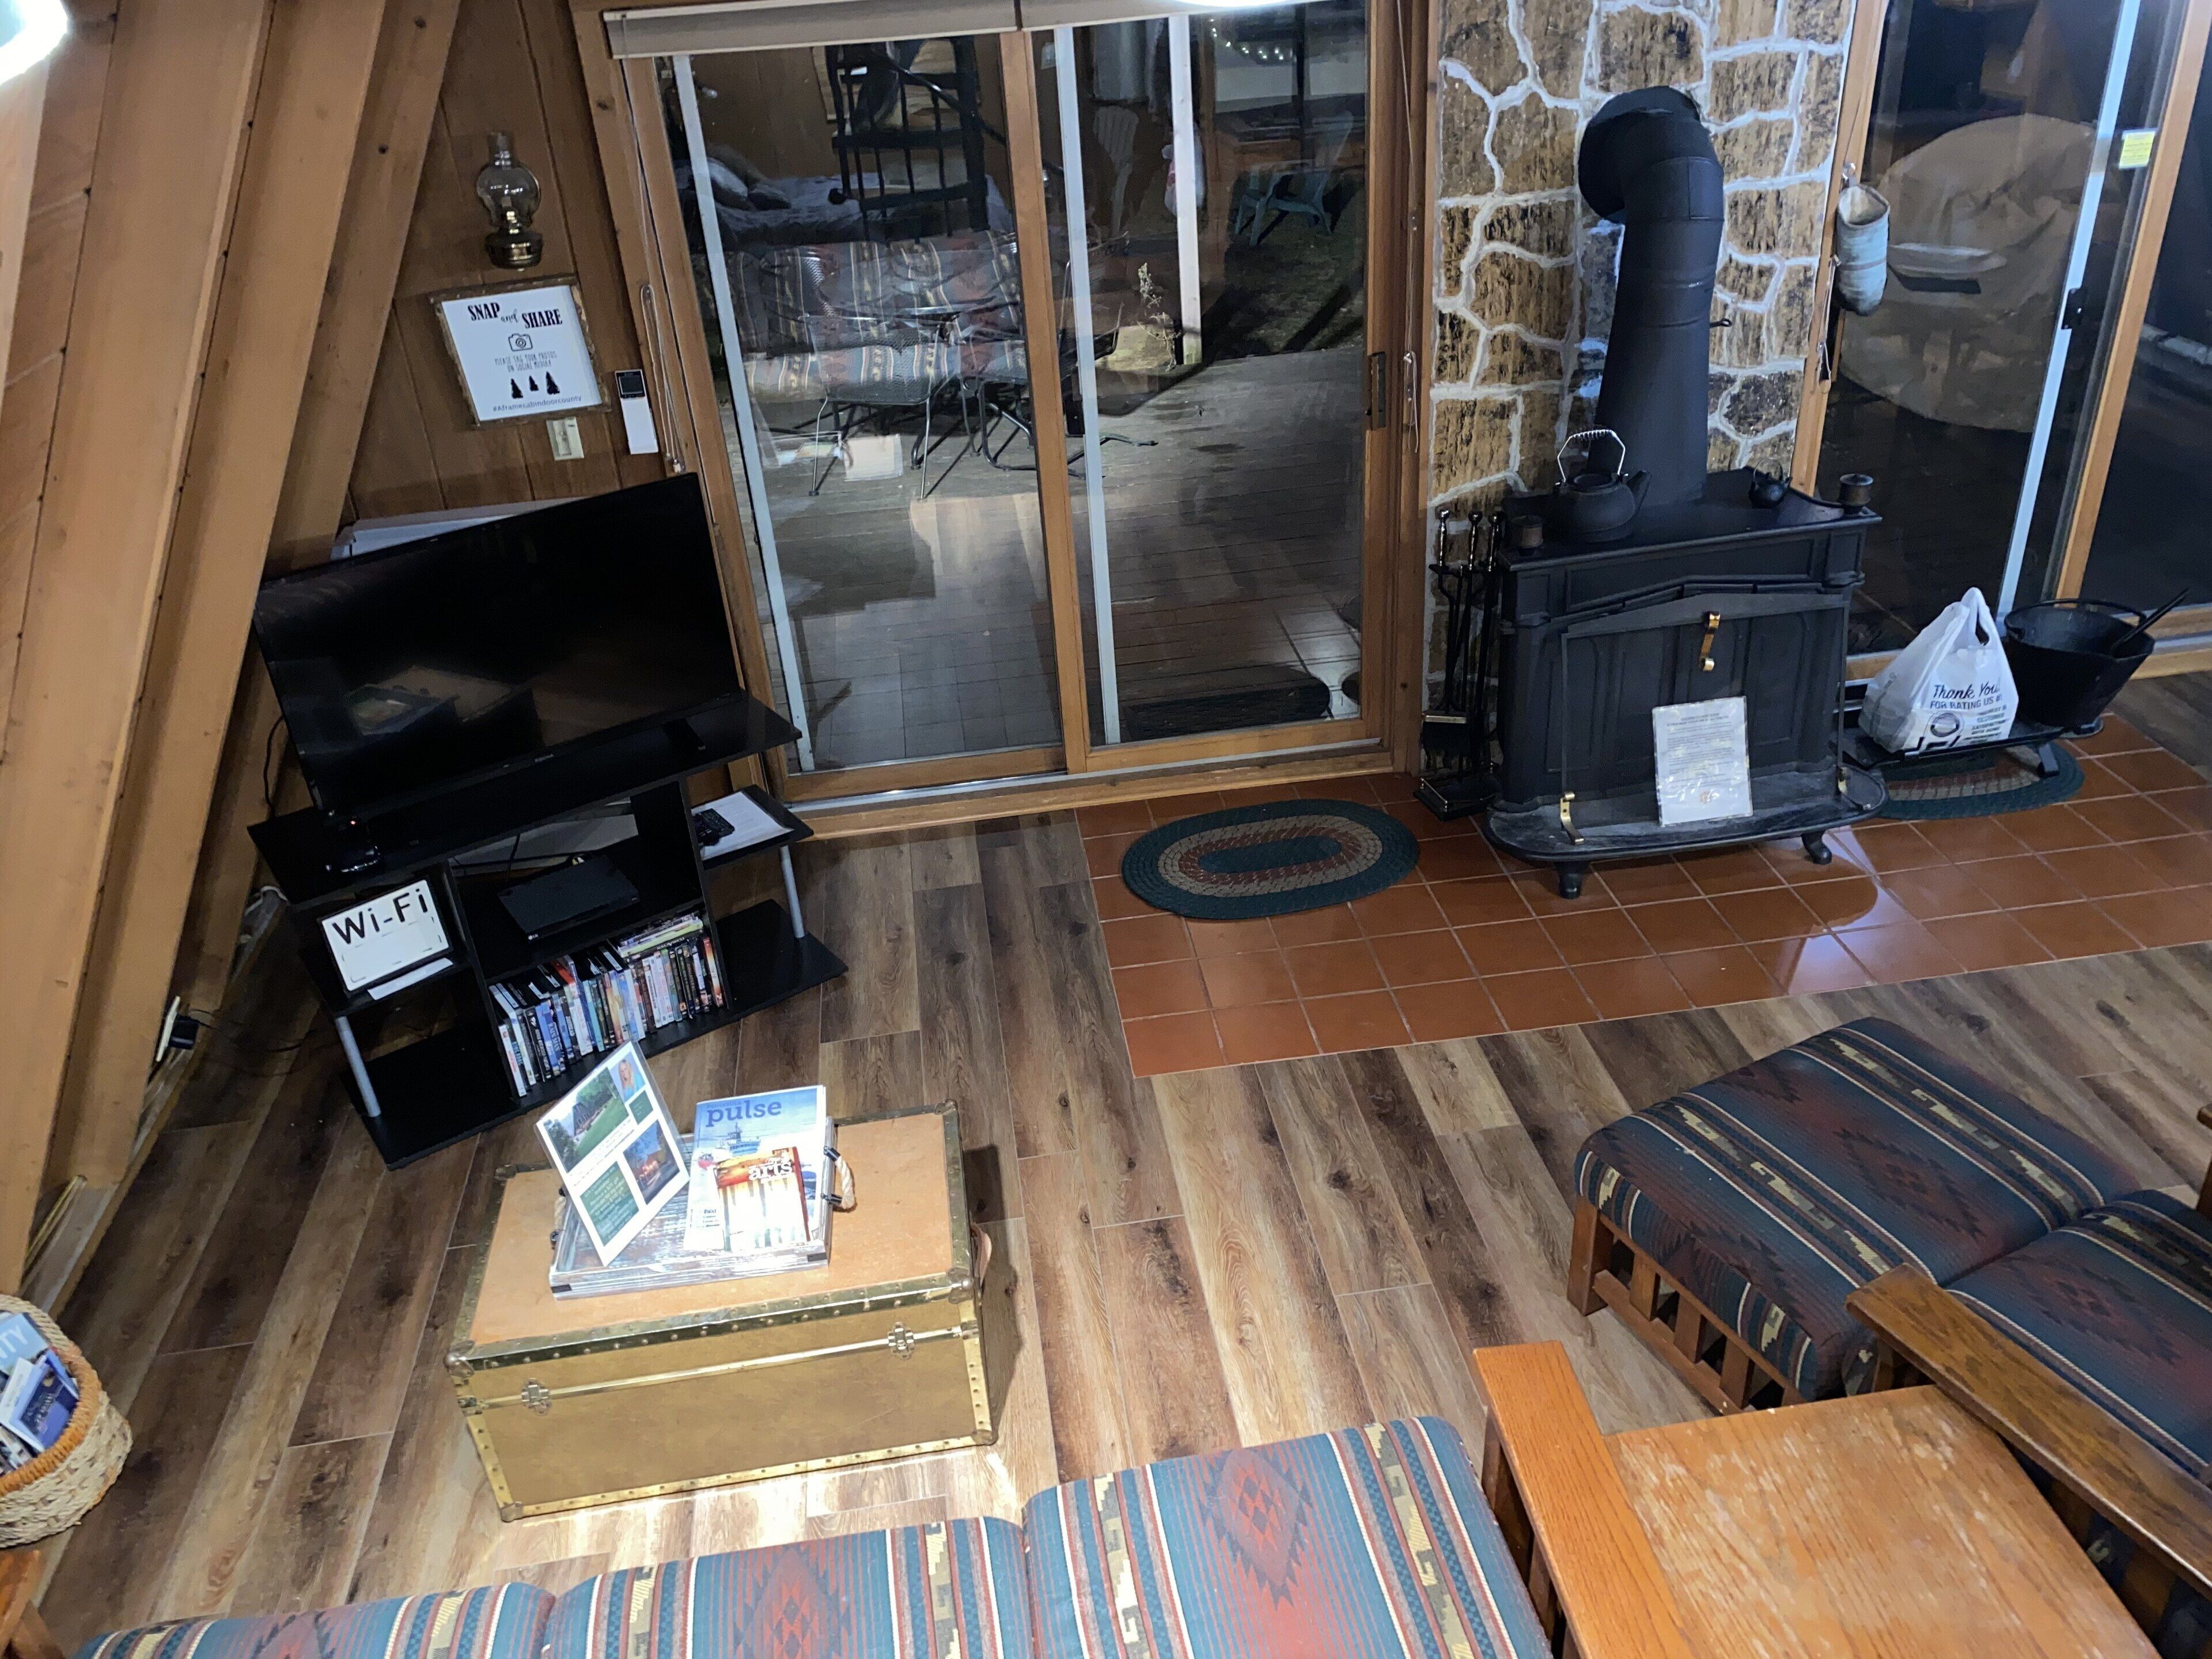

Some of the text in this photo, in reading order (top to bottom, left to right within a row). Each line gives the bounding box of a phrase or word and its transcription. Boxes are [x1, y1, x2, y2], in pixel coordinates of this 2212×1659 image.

[467, 302, 563, 329] SNAP and SHARE
[1933, 683, 1976, 699] Thank
[1930, 700, 1946, 709] FOR
[1950, 700, 1982, 710] RATING
[1984, 697, 1994, 705] US
[332, 888, 428, 944] Wi-Fi
[705, 1100, 782, 1127] pulse
[748, 1159, 793, 1181] arts
